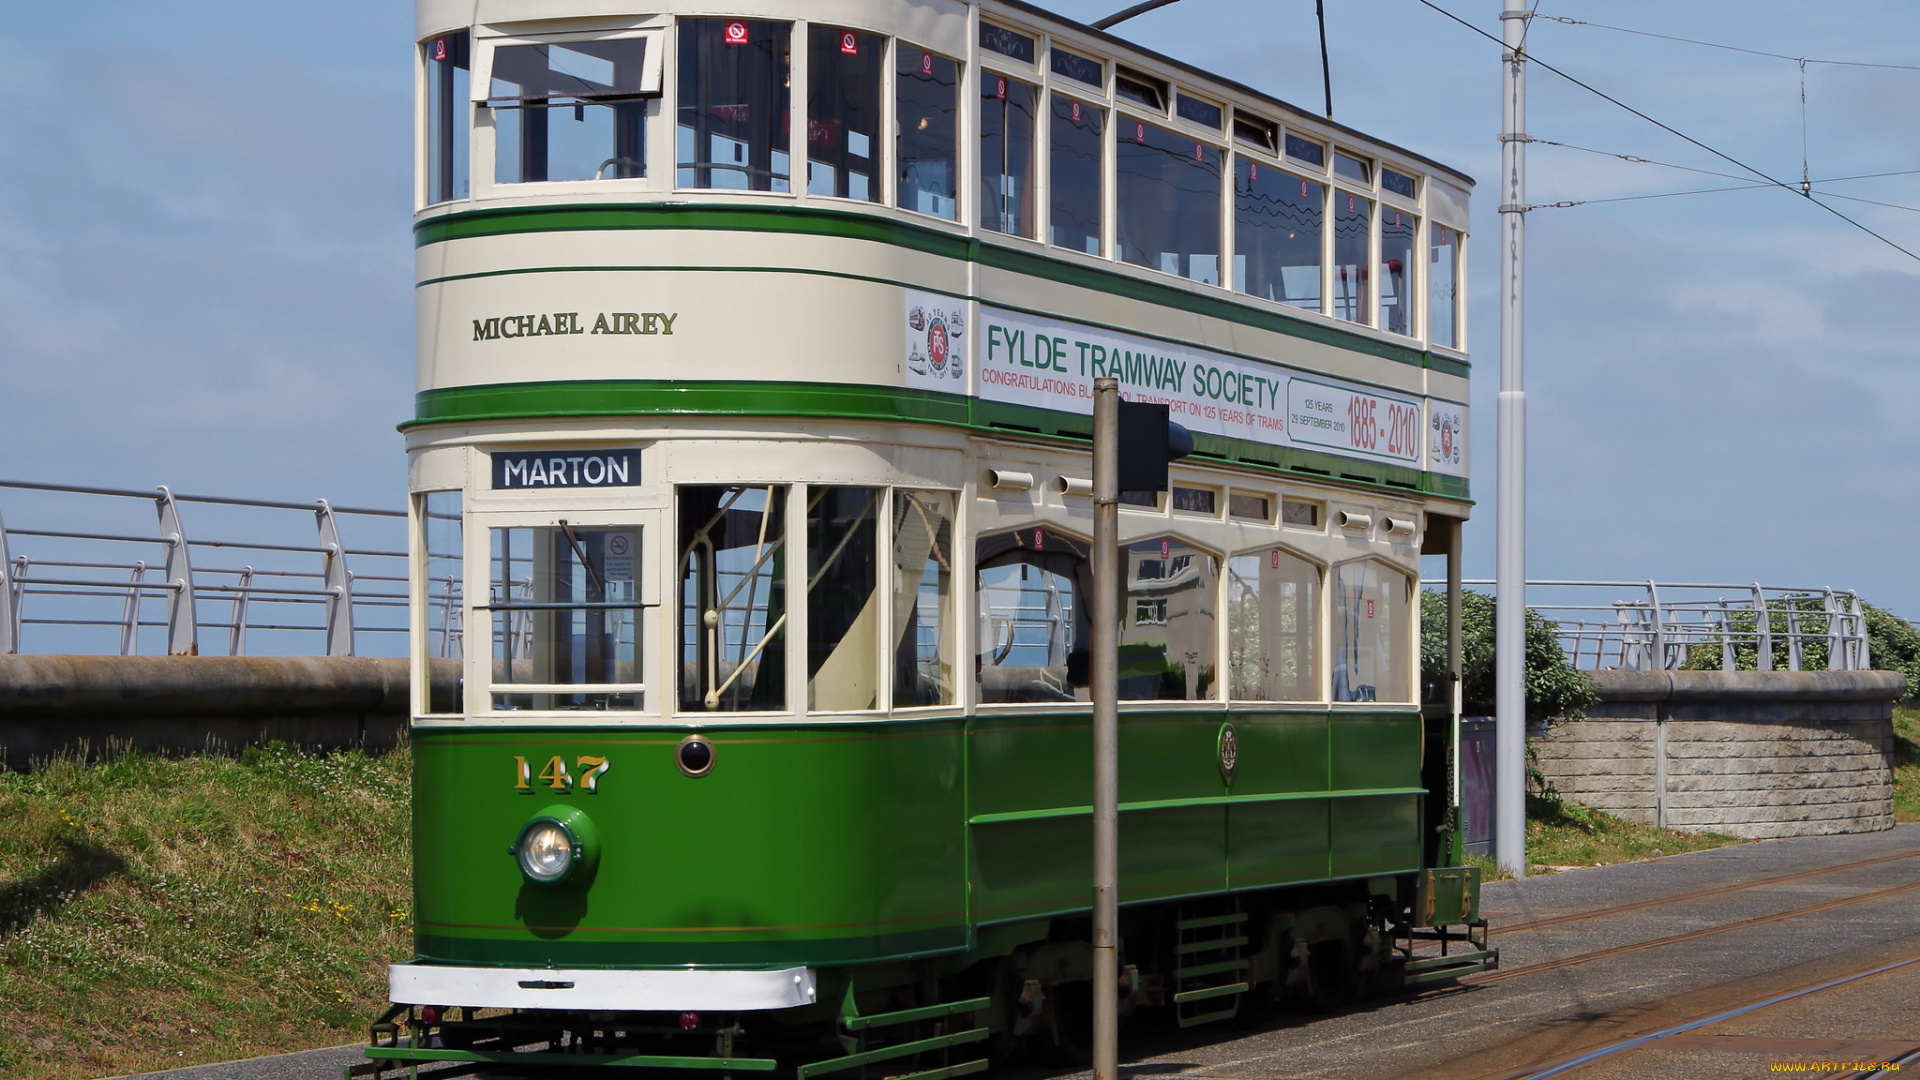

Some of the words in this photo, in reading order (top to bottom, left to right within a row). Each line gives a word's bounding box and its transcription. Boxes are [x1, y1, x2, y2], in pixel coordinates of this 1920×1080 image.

[473, 312, 584, 342] MICHAEL
[590, 312, 678, 336] AIREY
[987, 324, 1068, 374] FYLDE
[1074, 341, 1187, 394] TRAMWAY
[1193, 363, 1280, 411] SOCIETY
[981, 368, 1076, 396] CONGRATULATIONS
[1189, 402, 1202, 417] ON
[1203, 405, 1217, 420] 125
[1218, 407, 1244, 425] YEARS
[1245, 412, 1256, 427] OF
[1257, 415, 1284, 432] TRAMS
[1304, 398, 1314, 410] 125
[1315, 401, 1333, 414] YEARS
[1291, 412, 1299, 424] 29
[1299, 414, 1333, 431] SEPTEMBER
[1333, 421, 1346, 433] 2010
[1347, 394, 1377, 451] 1885
[1388, 403, 1416, 458] 2010
[504, 456, 629, 486] MARTON
[513, 755, 612, 795] 147
